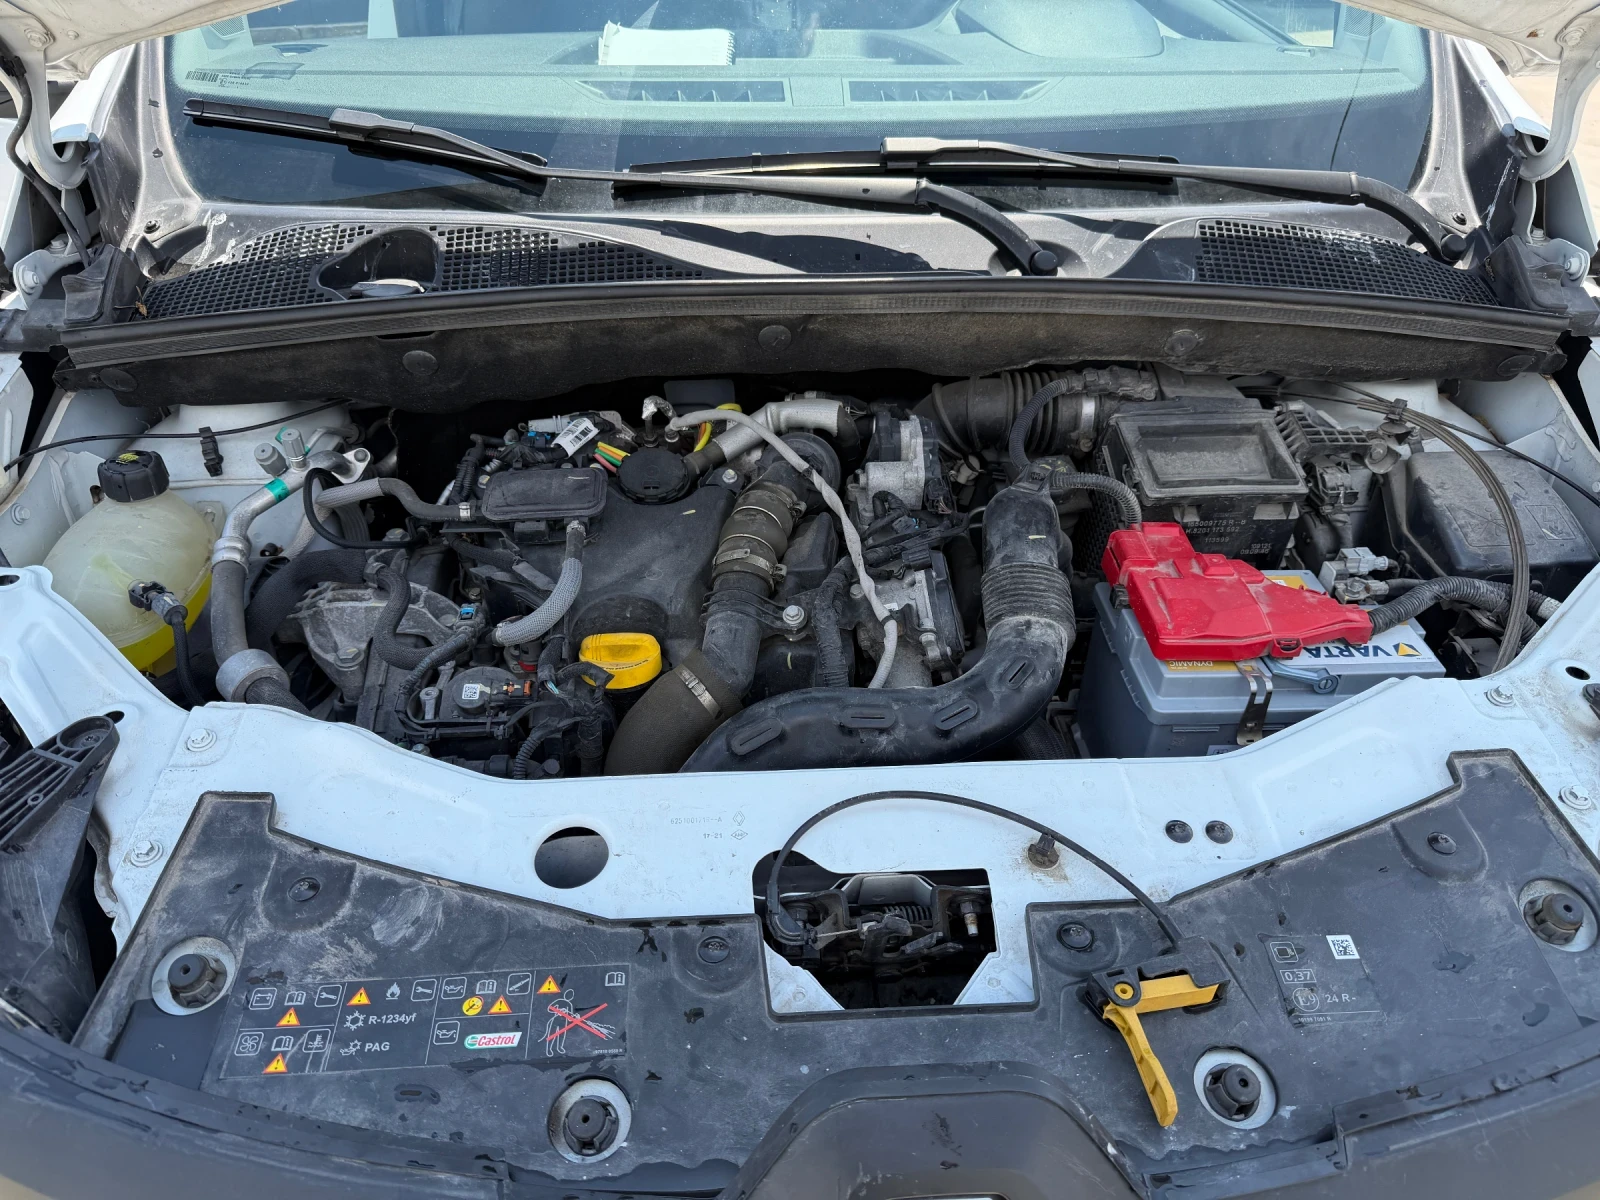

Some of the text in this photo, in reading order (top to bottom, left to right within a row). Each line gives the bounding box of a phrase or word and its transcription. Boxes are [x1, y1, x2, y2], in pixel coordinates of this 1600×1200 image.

[1302, 645, 1393, 658] VARTA
[1324, 994, 1339, 1003] 24
[368, 1013, 417, 1025] R-1234yf
[477, 1034, 517, 1046] Castrol
[364, 1041, 390, 1052] PAG
